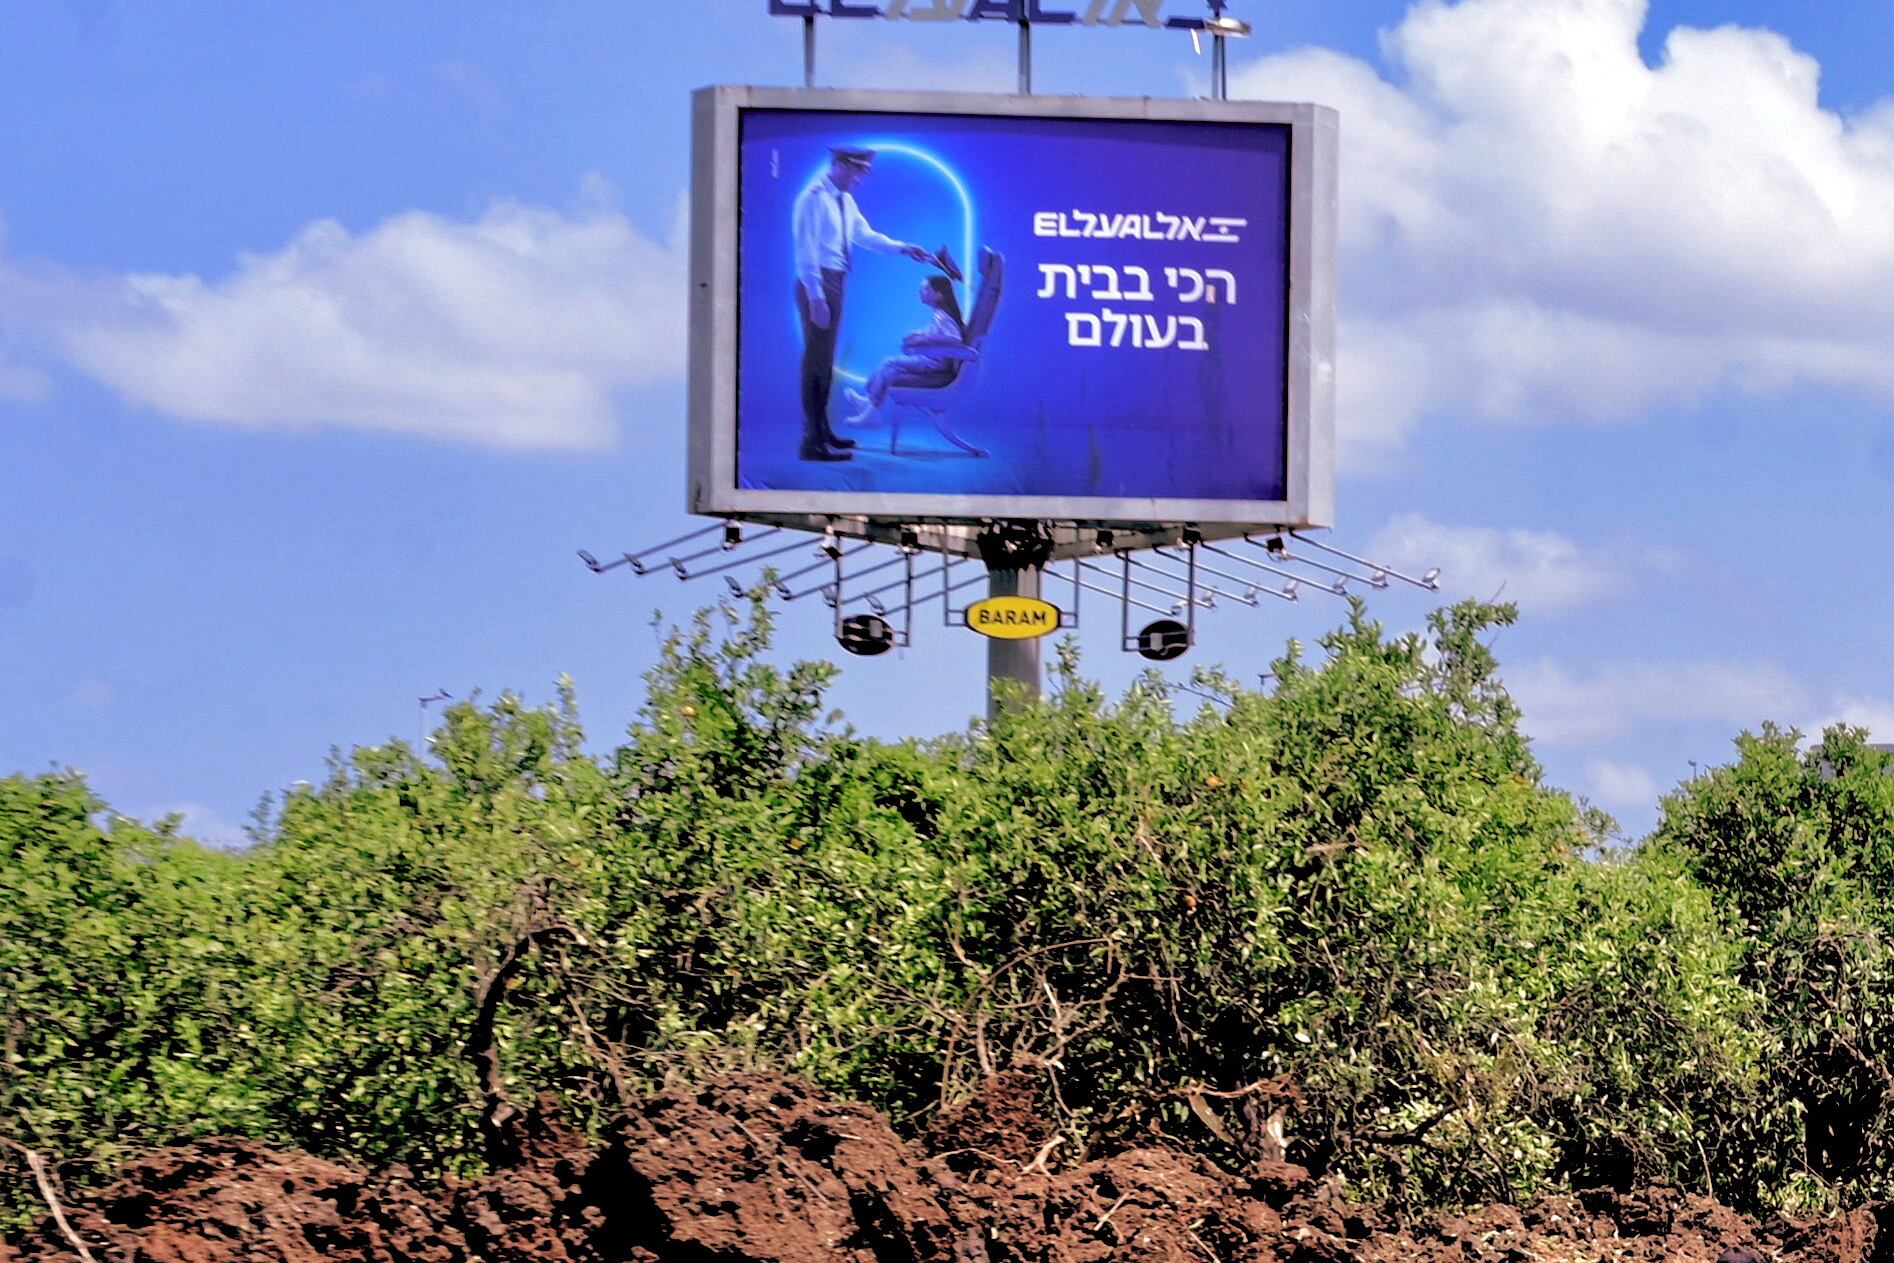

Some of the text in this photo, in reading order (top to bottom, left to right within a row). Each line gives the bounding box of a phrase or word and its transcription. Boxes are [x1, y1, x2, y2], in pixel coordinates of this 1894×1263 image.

[1037, 263, 1237, 305] הכי בבית
[1064, 308, 1209, 351] בעולם
[979, 609, 1047, 625] BARAM
